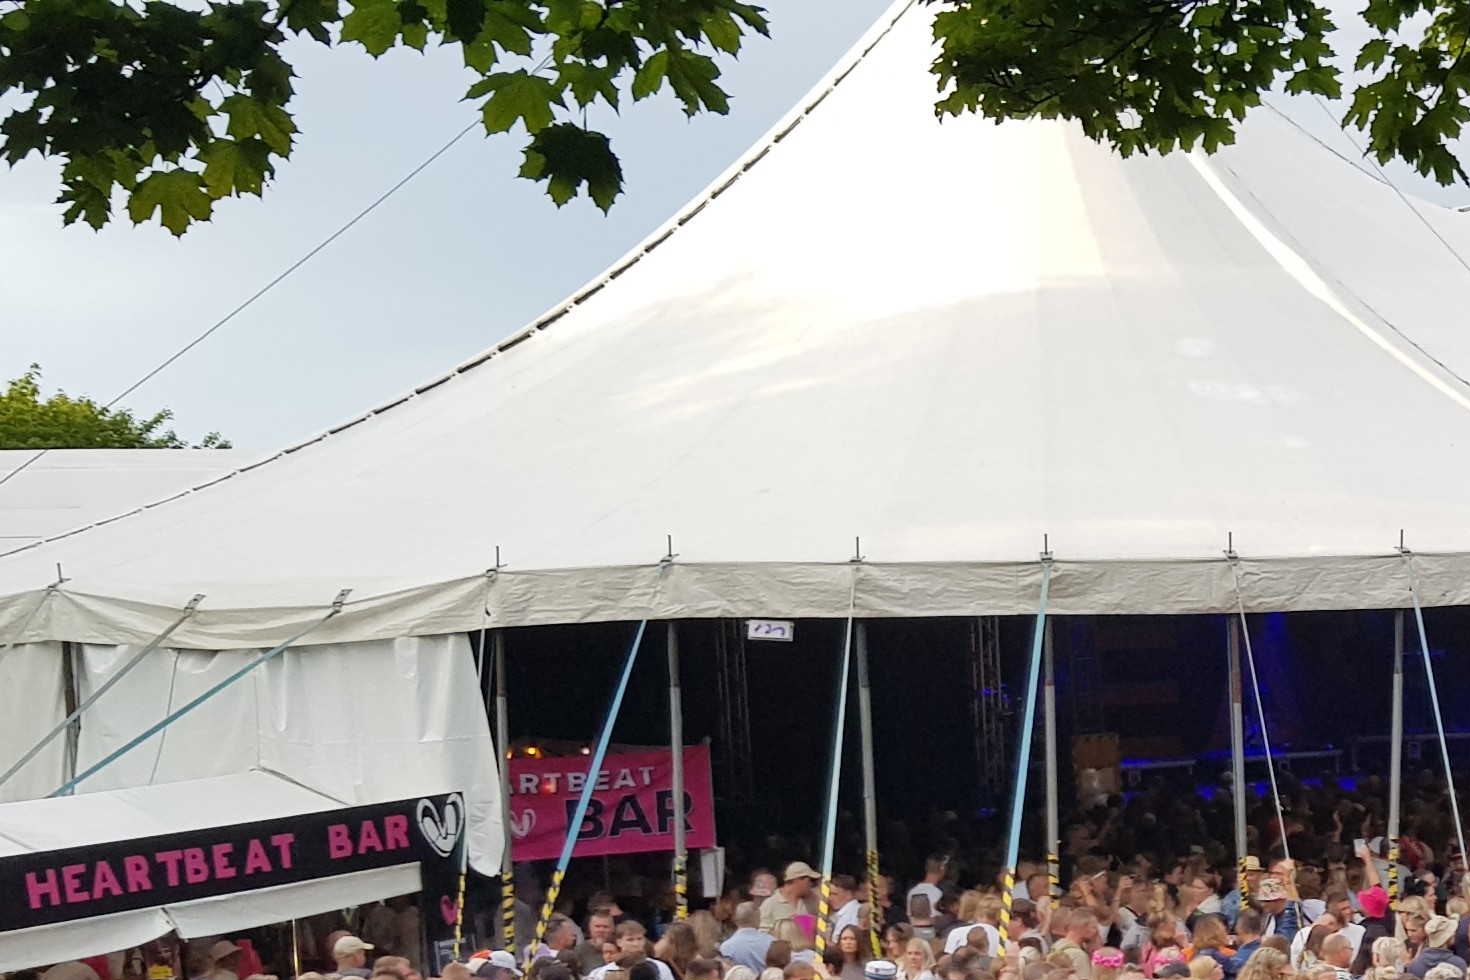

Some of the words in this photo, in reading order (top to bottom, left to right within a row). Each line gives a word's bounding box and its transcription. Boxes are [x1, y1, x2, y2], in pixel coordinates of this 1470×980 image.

[565, 788, 695, 842] BAR
[24, 832, 296, 909] HEARTBEAT
[327, 814, 410, 860] BAR
